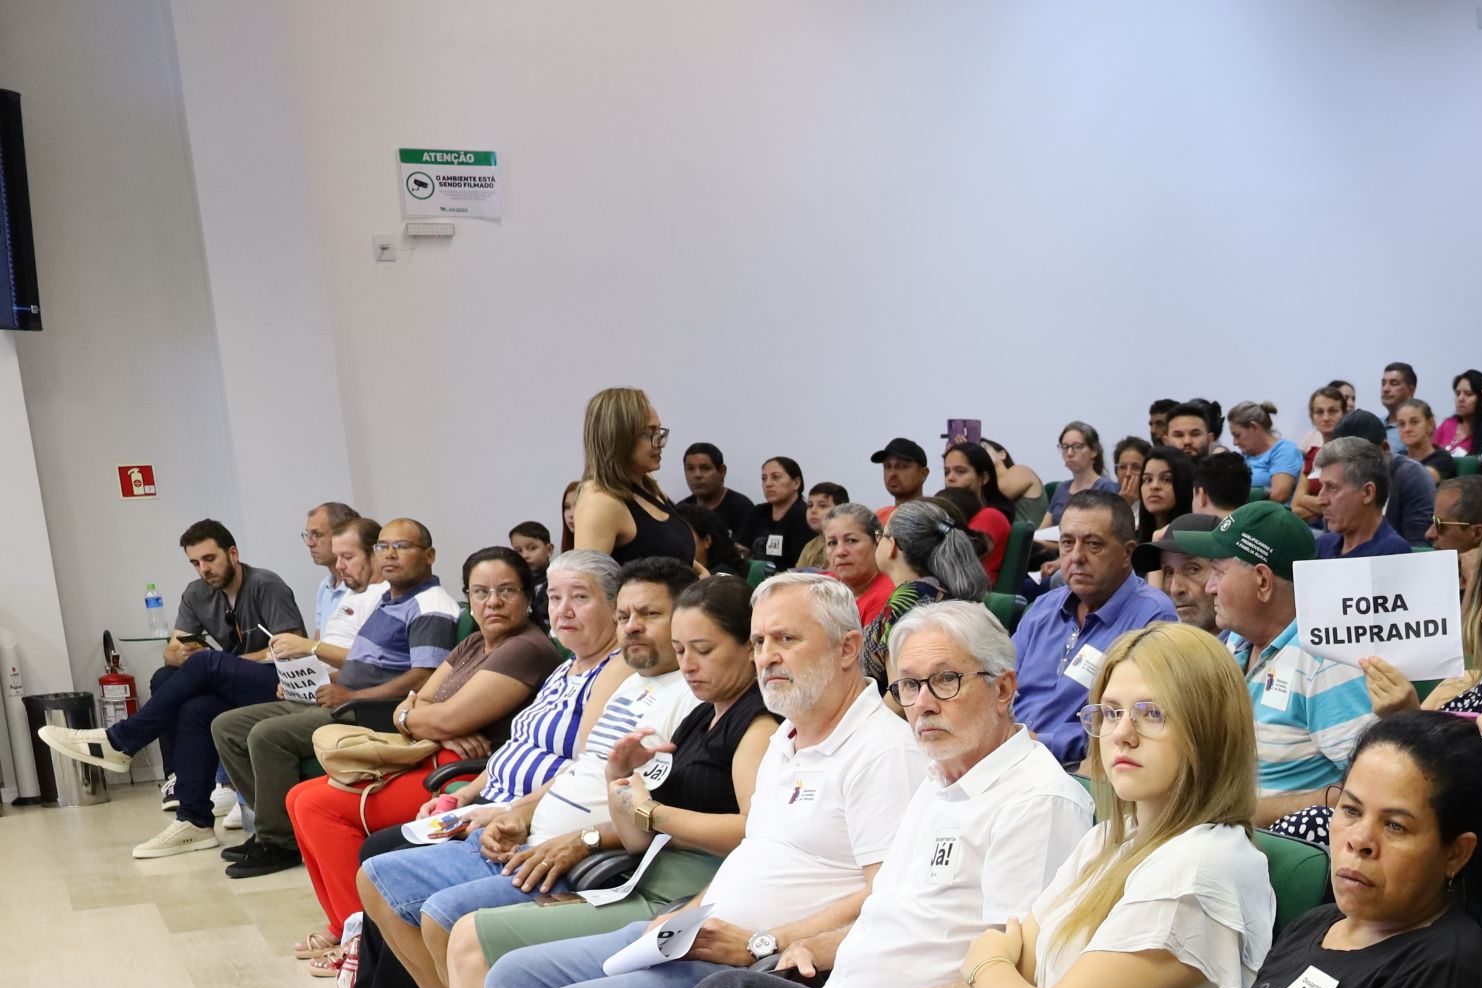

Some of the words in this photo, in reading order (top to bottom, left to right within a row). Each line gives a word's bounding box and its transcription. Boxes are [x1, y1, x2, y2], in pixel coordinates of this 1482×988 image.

[422, 152, 475, 165] ATENÇÃO
[1342, 594, 1408, 615] FORA
[1310, 618, 1447, 645] SILIPRANDI
[643, 763, 669, 782] Já!
[930, 842, 953, 866] Já!
